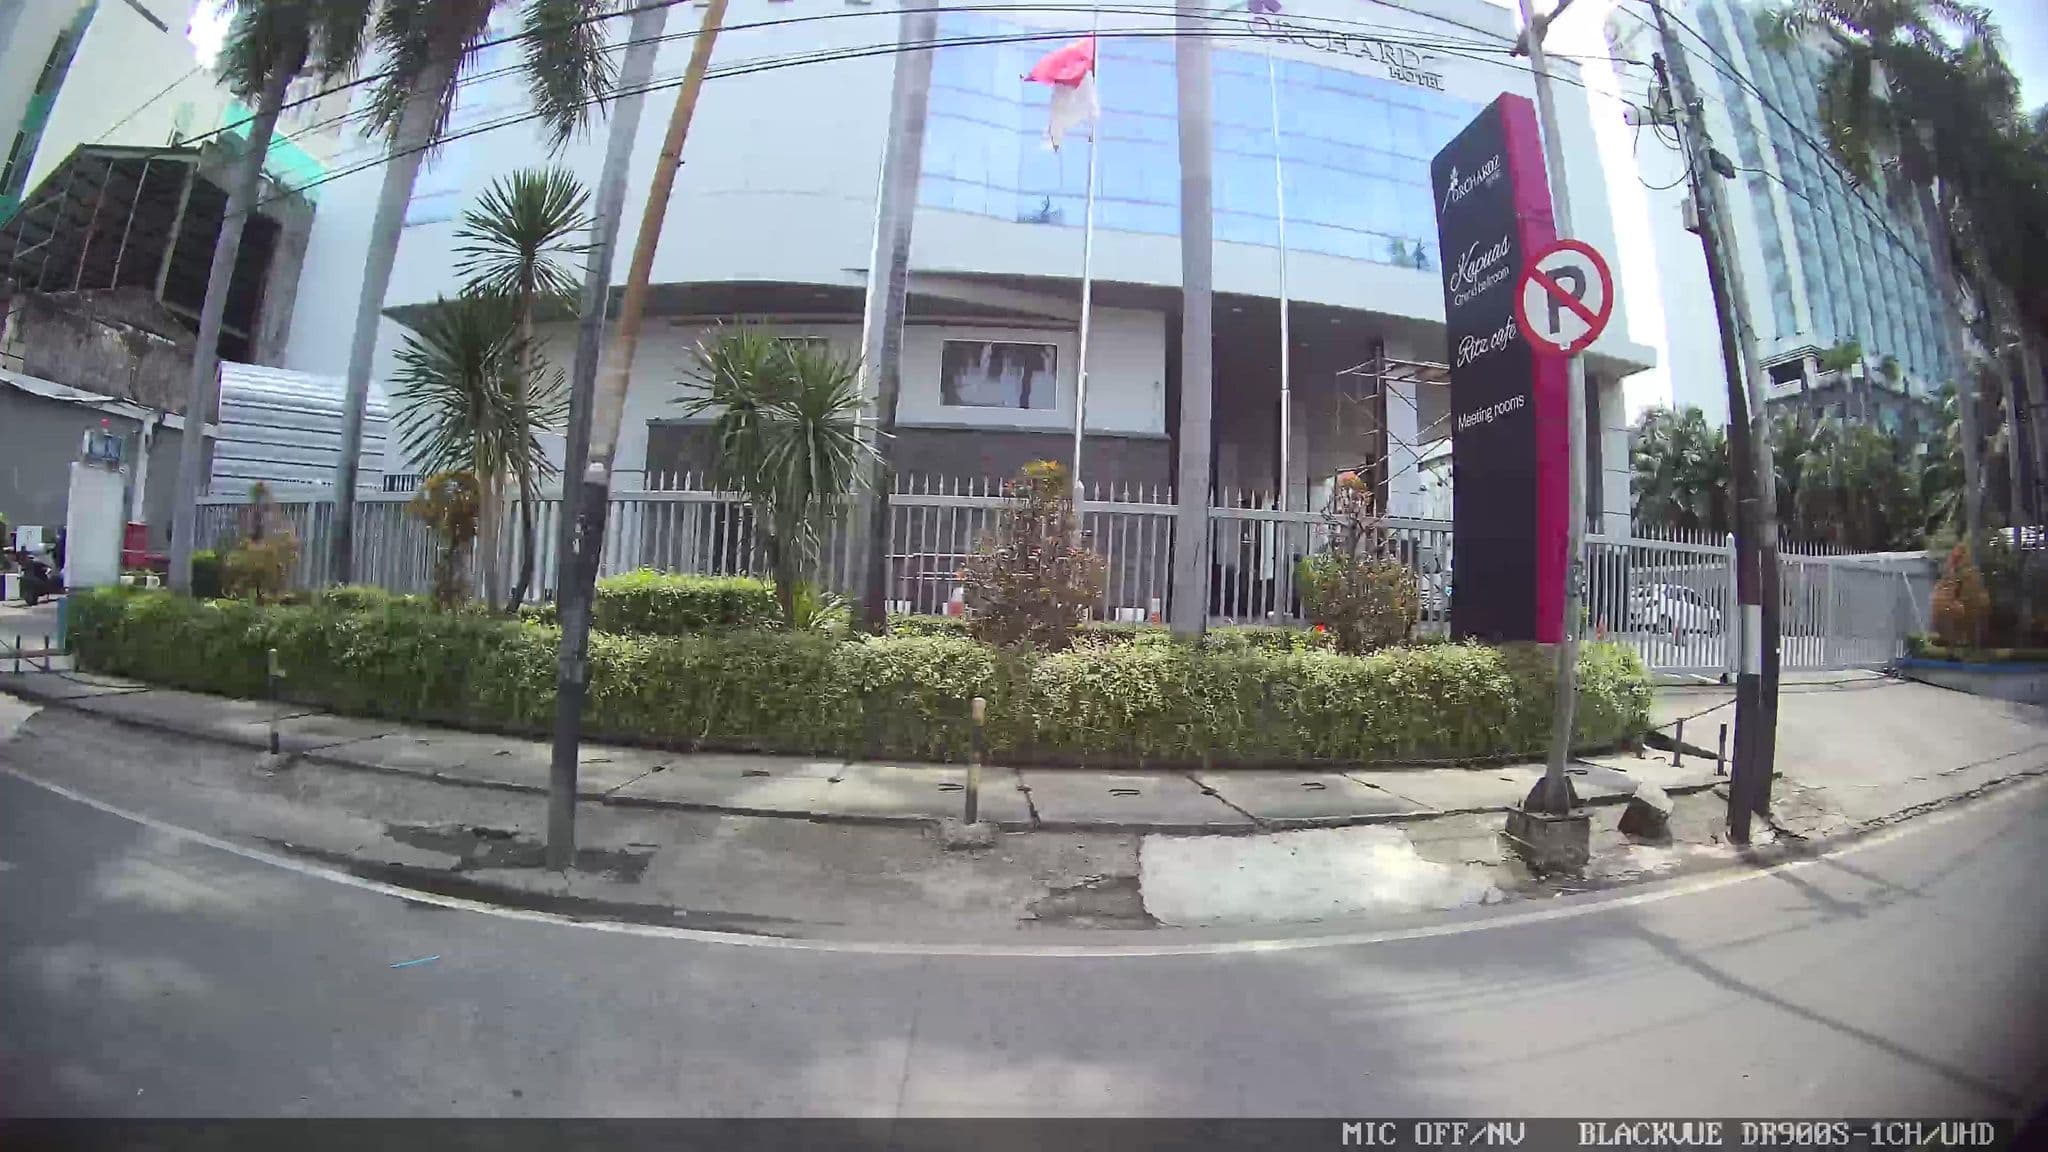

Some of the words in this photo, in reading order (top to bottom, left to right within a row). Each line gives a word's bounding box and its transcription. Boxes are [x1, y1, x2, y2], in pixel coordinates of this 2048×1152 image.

[1389, 66, 1445, 91] HOTEL
[1452, 154, 1500, 202] ORCHARDZ
[1450, 234, 1510, 292] Kapuas
[1545, 265, 1587, 335] P
[1457, 335, 1489, 368] Ritz
[1458, 406, 1494, 432] Meeting
[1494, 394, 1525, 417] rooms
